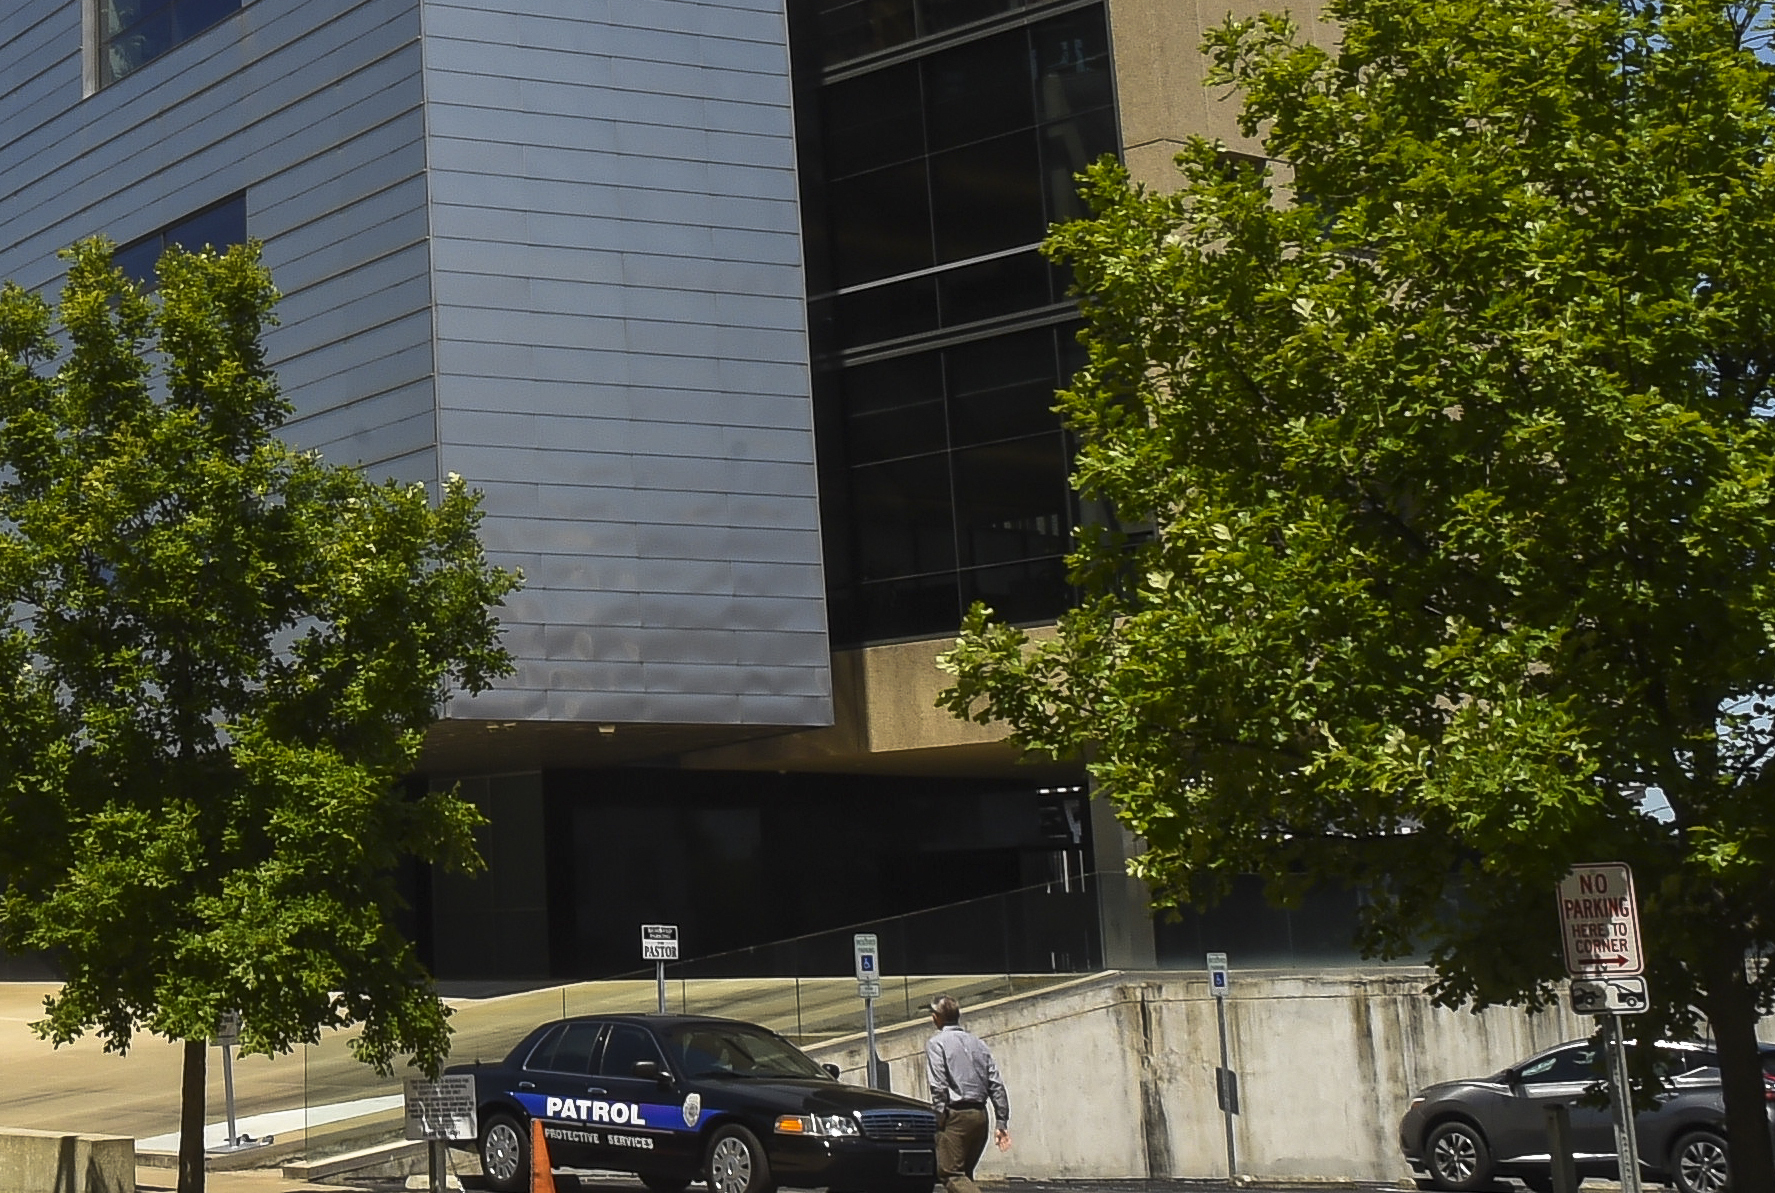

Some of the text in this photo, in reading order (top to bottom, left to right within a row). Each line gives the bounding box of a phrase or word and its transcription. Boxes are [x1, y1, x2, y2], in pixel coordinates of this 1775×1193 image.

[1579, 873, 1608, 894] NO
[1564, 897, 1630, 919] PARKING
[1572, 922, 1628, 938] HERE TO
[645, 945, 677, 957] PASTOR
[1575, 938, 1628, 954] CORNER
[546, 1096, 646, 1126] PATROL
[545, 1128, 654, 1149] PROTECTIVE SERVICES
